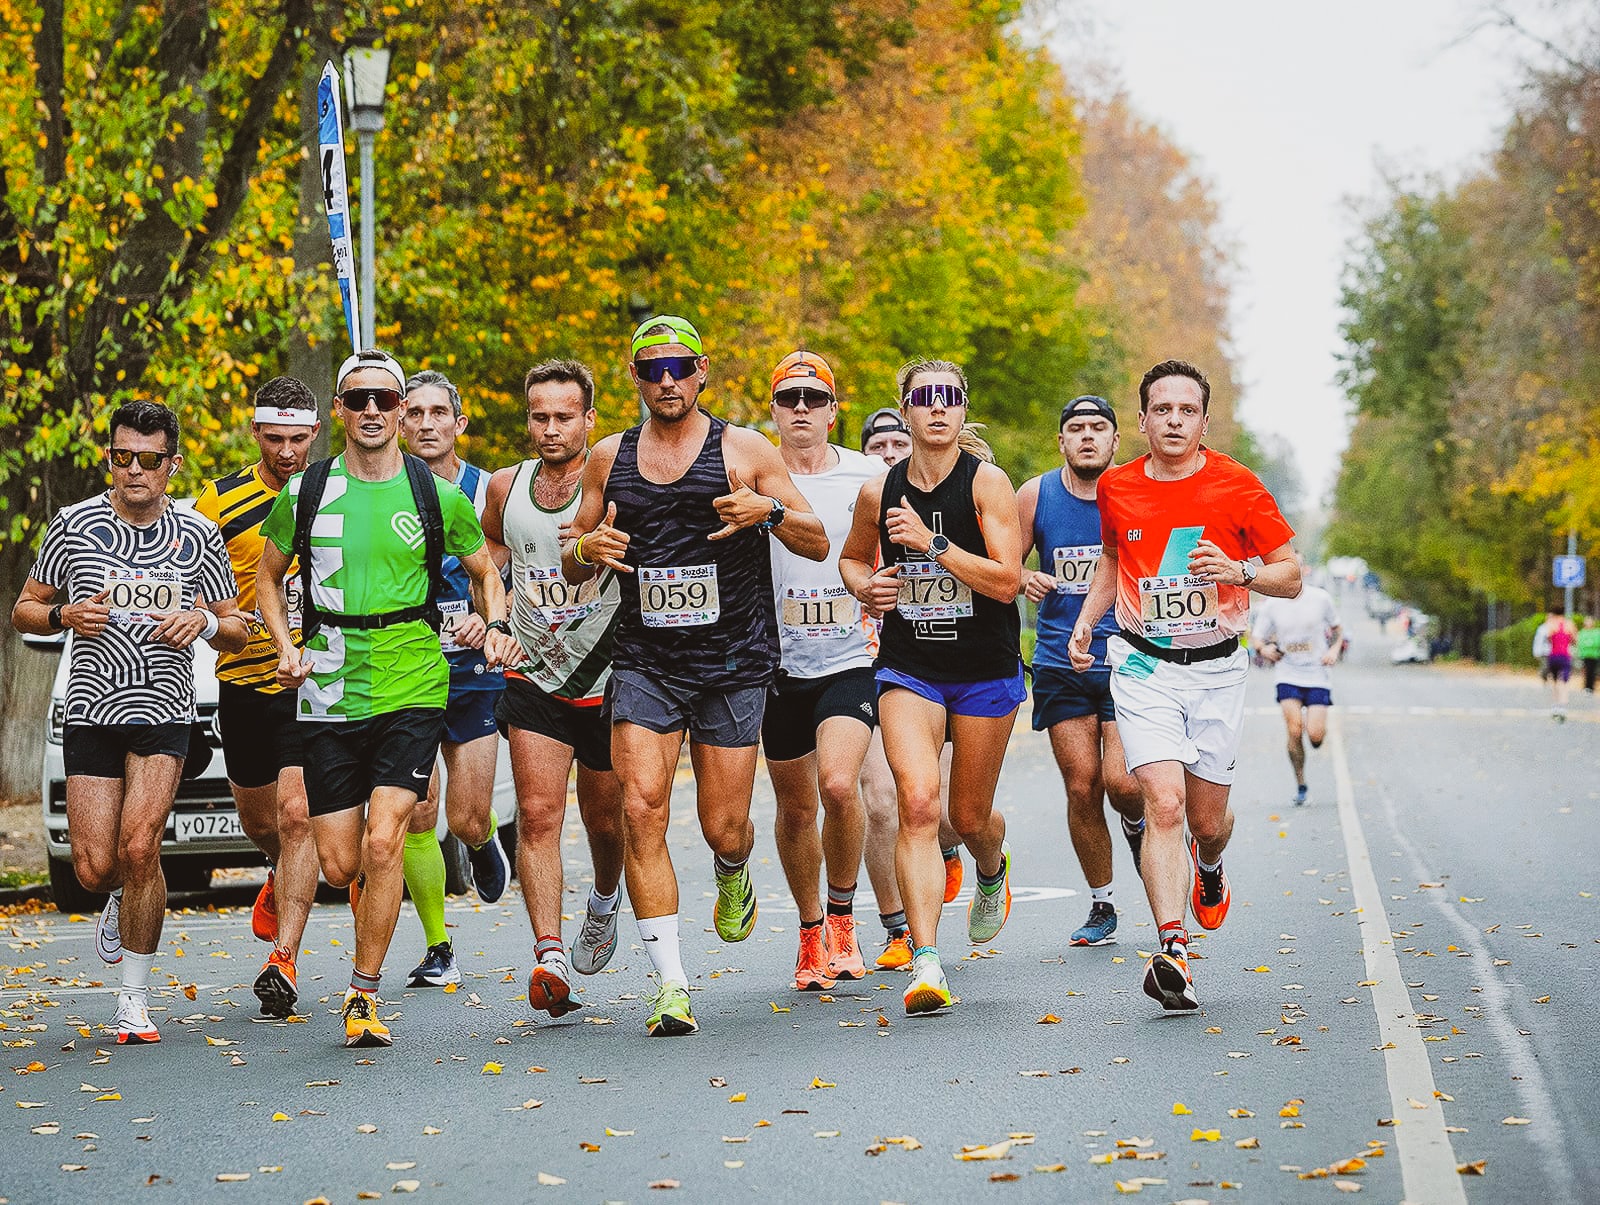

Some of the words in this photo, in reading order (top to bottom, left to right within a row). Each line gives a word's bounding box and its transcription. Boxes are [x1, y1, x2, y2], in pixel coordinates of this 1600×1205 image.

[680, 567, 709, 576] Suzdal
[1062, 560, 1098, 581] 07
[113, 584, 172, 610] 080
[648, 582, 707, 610] 059
[907, 577, 957, 603] 179
[799, 601, 837, 625] 111
[1152, 590, 1206, 620] 150
